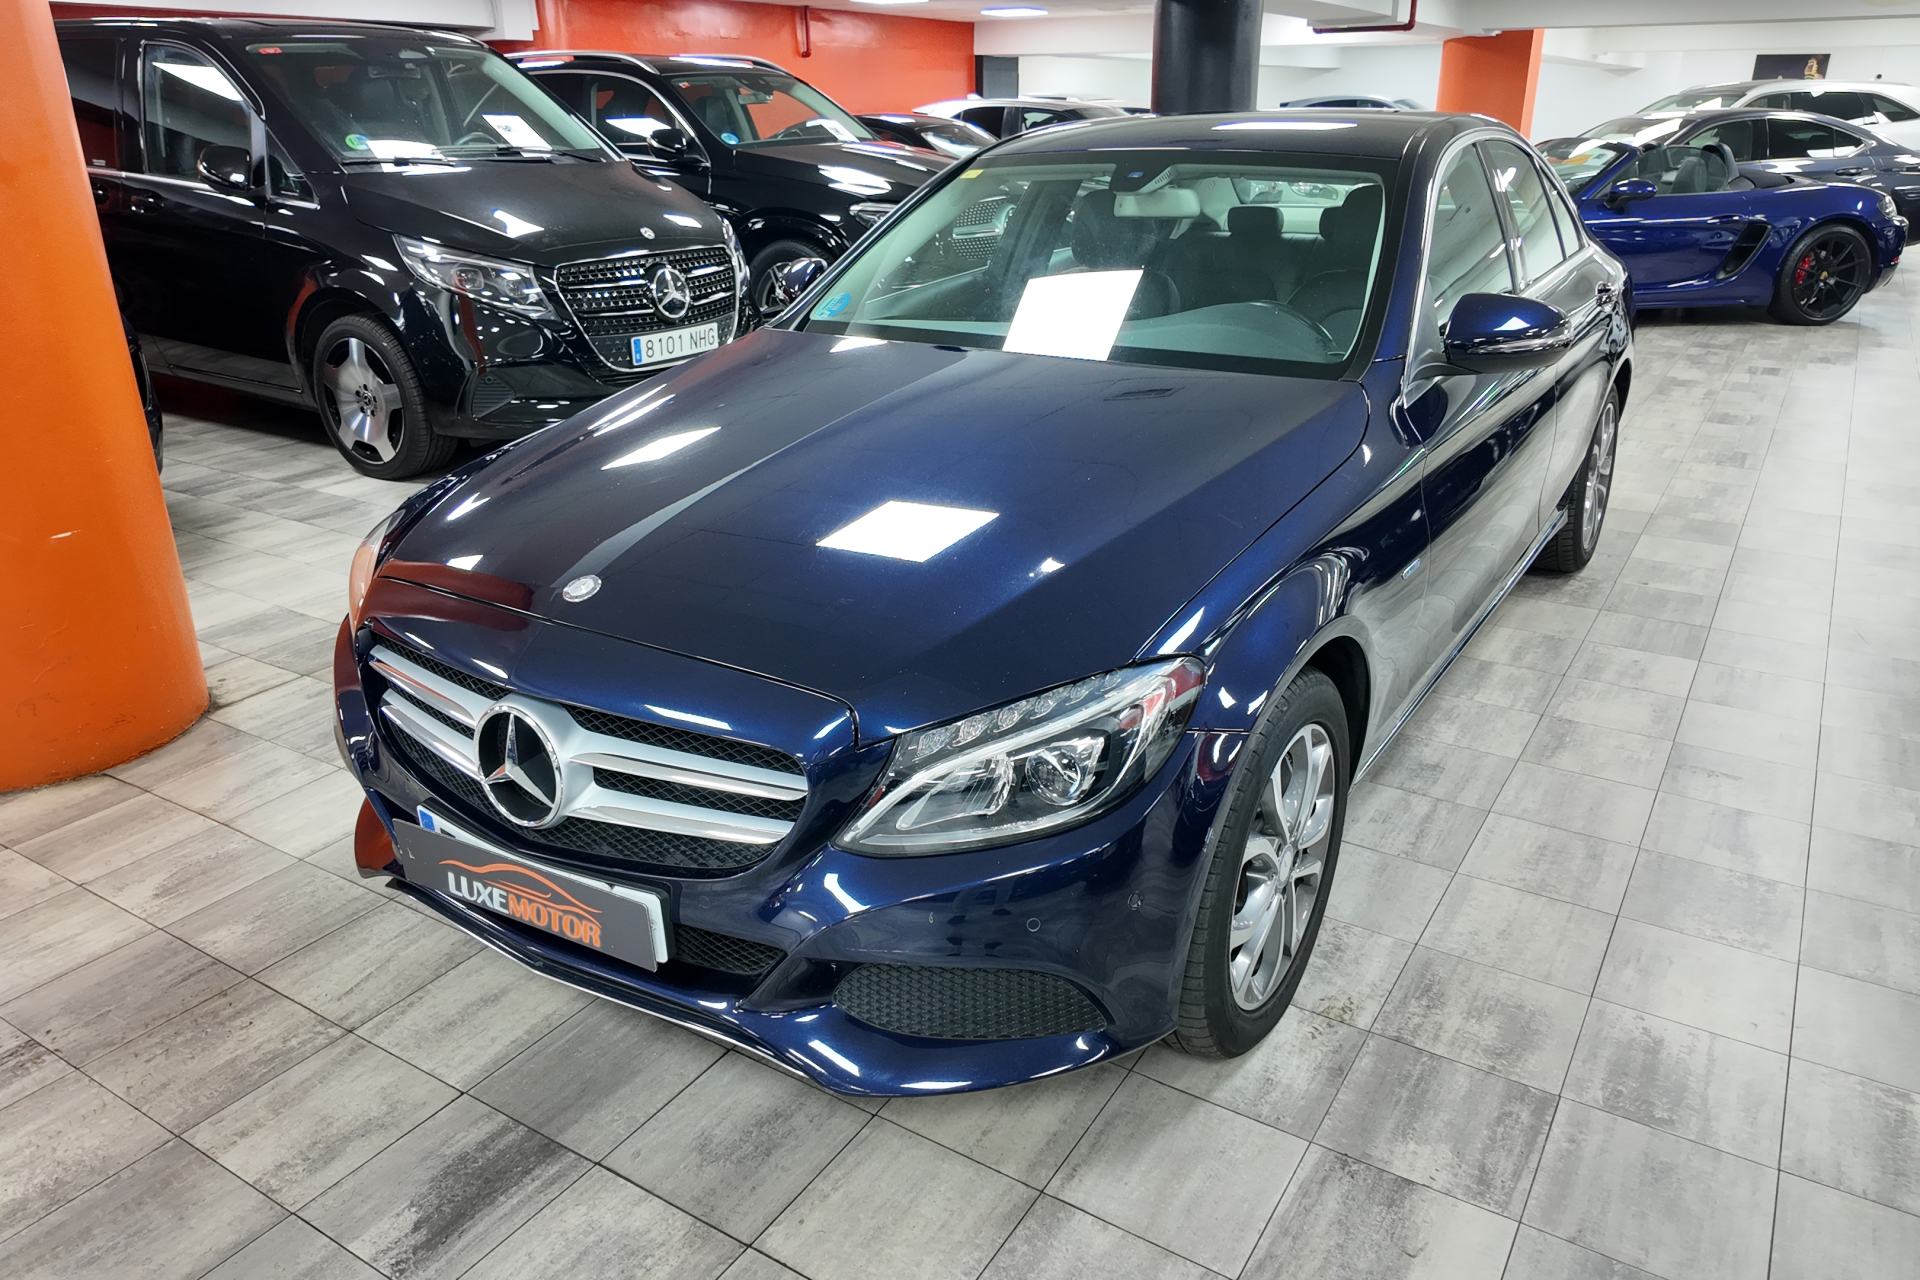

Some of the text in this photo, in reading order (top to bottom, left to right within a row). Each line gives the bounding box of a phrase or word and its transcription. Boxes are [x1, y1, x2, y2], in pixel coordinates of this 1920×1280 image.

[645, 327, 715, 358] 8101 NHG
[447, 871, 603, 948] LUXEMOTOR
